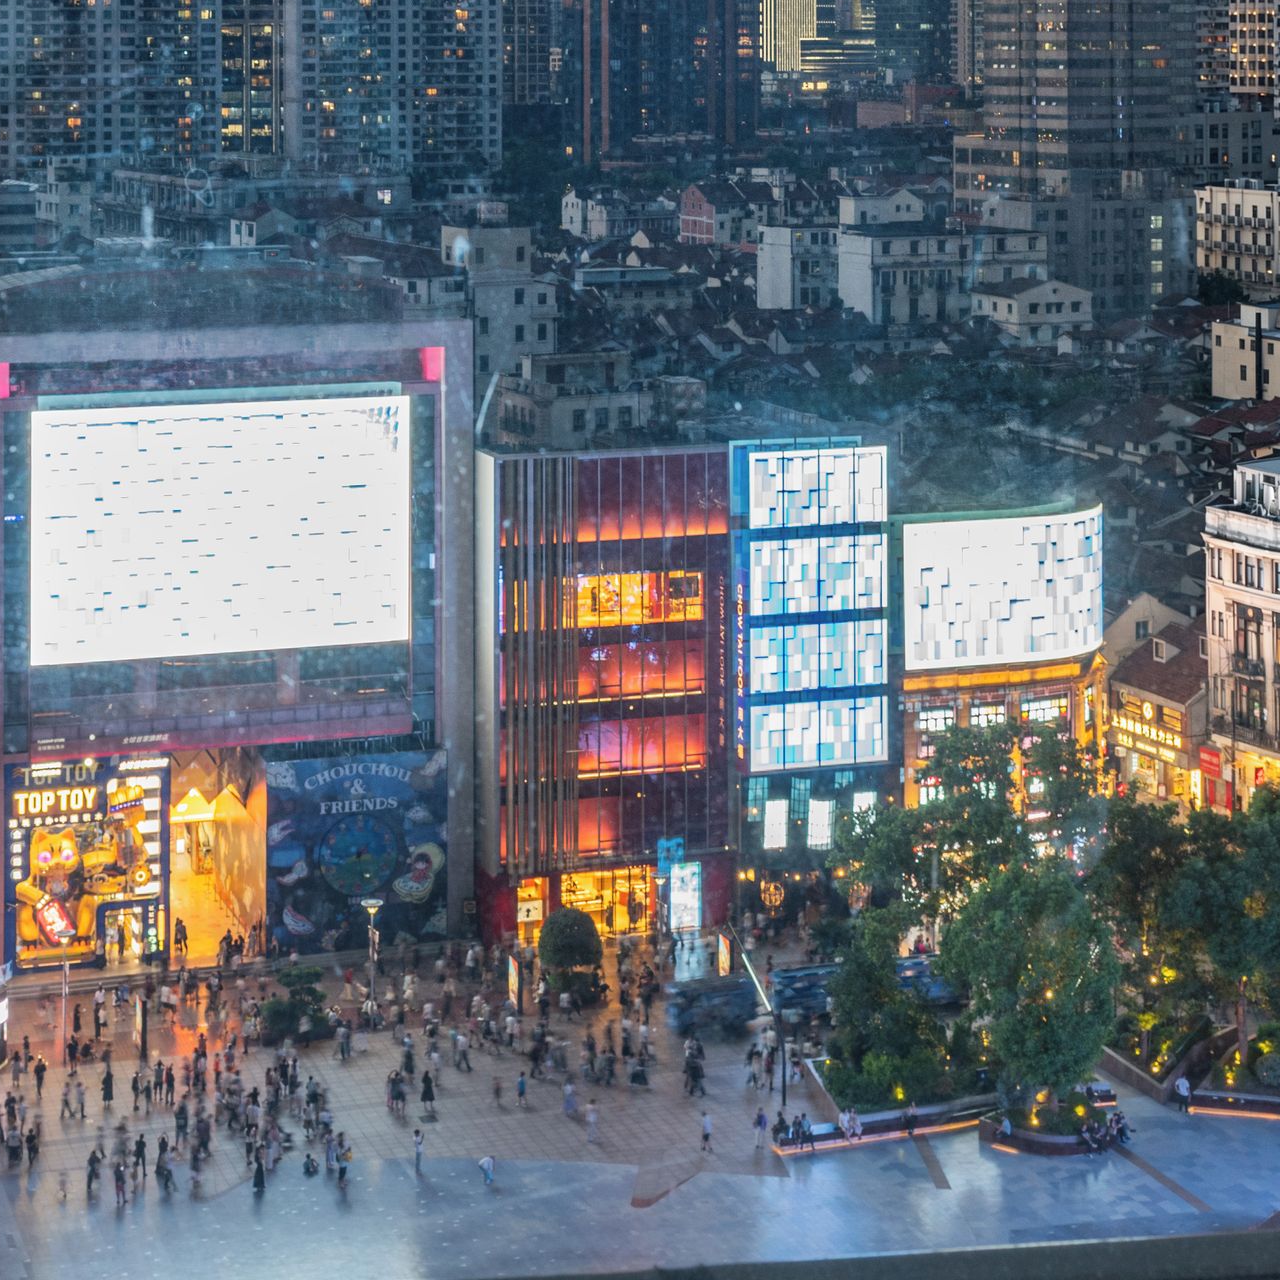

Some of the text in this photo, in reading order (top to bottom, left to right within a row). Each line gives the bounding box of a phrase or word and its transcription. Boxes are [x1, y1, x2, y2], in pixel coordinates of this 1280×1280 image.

[304, 763, 412, 790] CHOUCHOU
[350, 779, 367, 795] &
[13, 787, 97, 815] TOP TOY
[319, 796, 398, 814] FRIENDS
